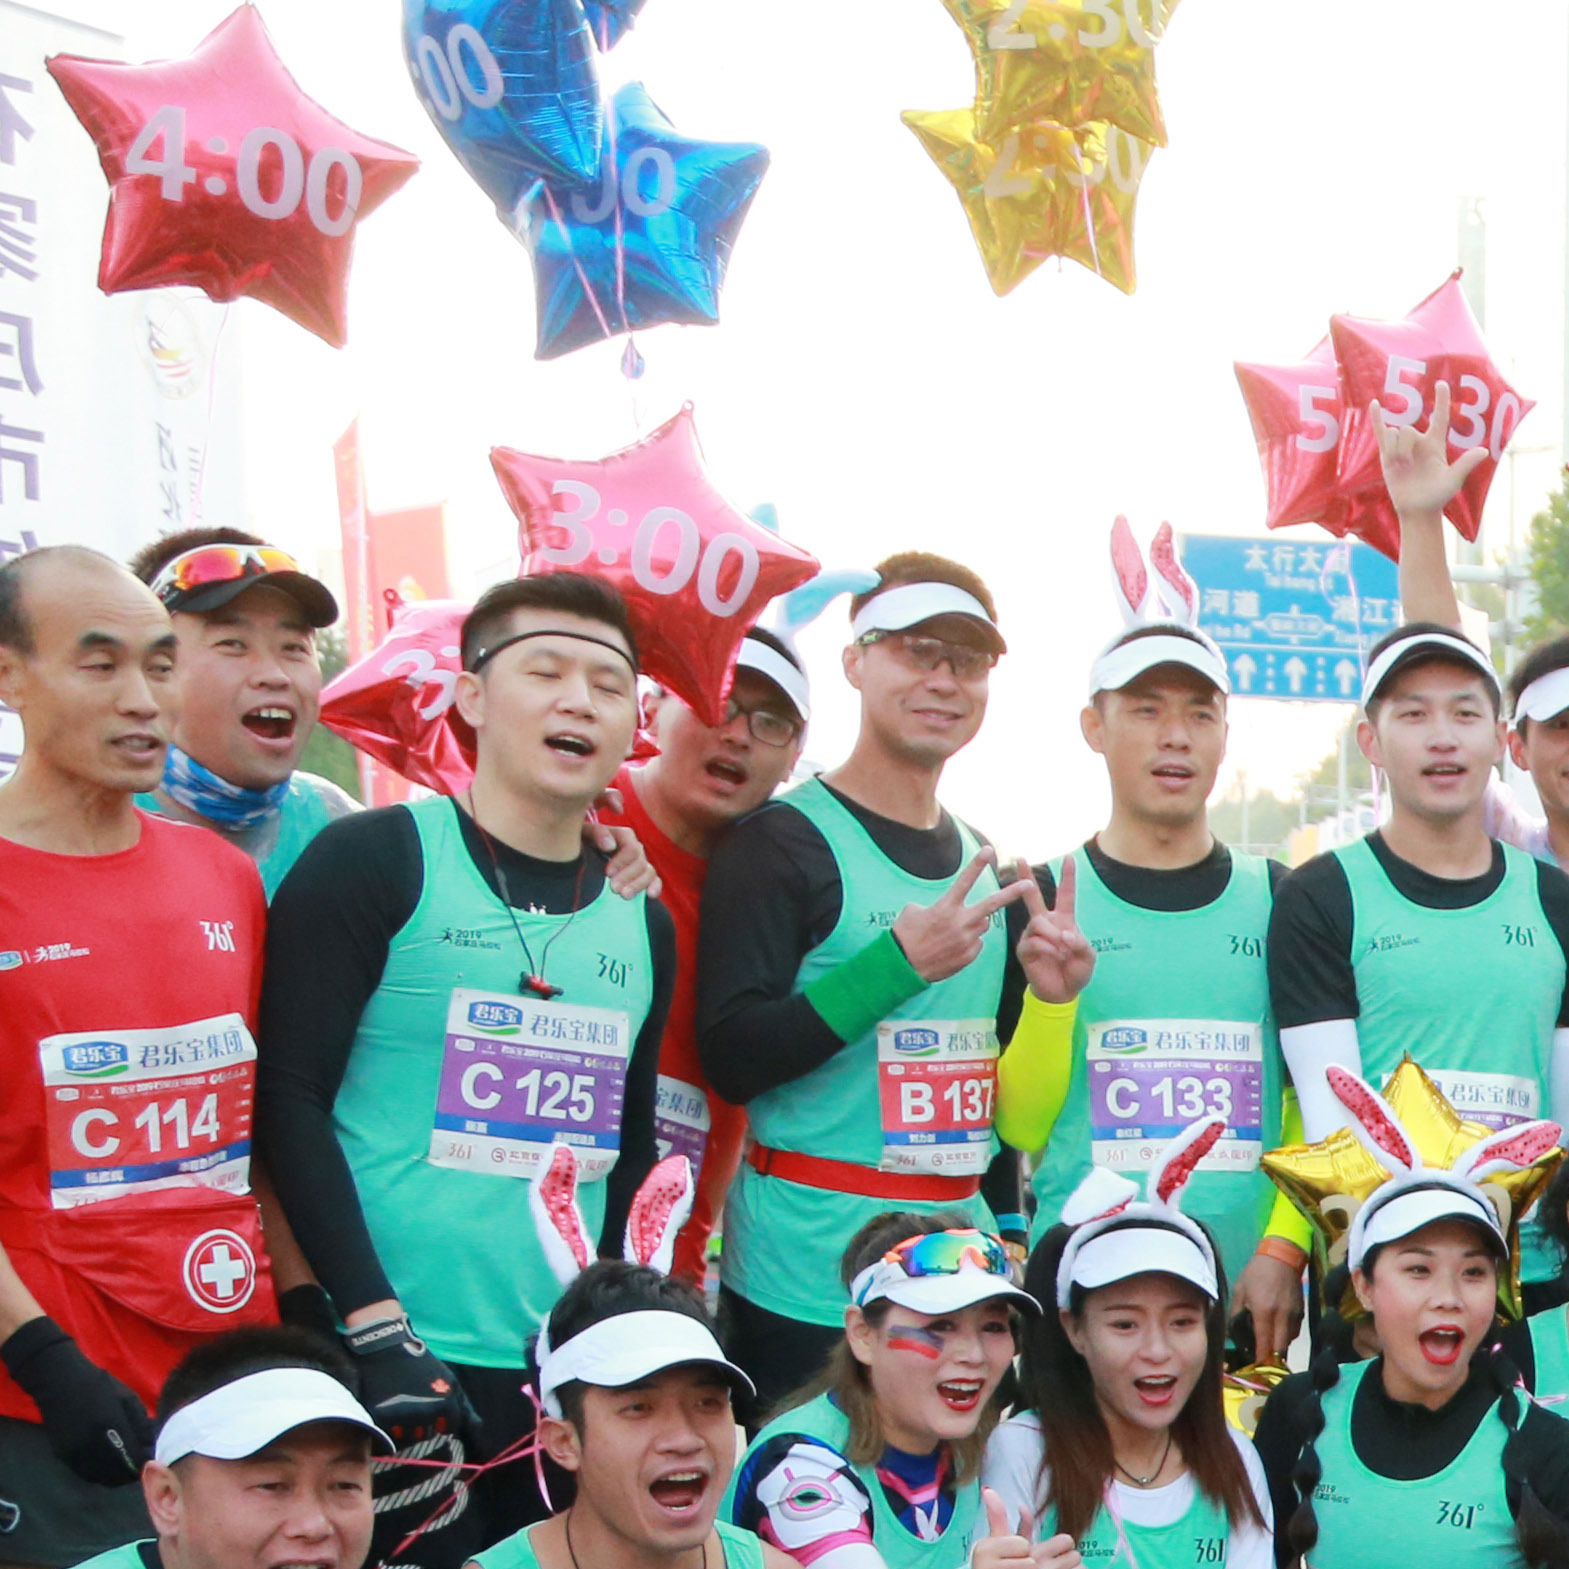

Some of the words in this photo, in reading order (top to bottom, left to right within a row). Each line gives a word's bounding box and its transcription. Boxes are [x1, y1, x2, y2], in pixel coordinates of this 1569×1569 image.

[127, 104, 364, 237] 4:00
[540, 480, 763, 616] 3:00
[200, 920, 234, 952] 361°
[456, 930, 482, 939] 2019
[597, 952, 633, 988] 361°
[475, 1005, 518, 1023] 君乐宝
[531, 1014, 619, 1046] 君乐宝集团
[71, 1045, 122, 1063] 君乐宝
[139, 1030, 244, 1068] 君乐宝集团
[900, 1031, 936, 1045] 君乐宝
[1155, 1031, 1250, 1051] 君乐宝集团
[461, 1062, 504, 1110] C
[516, 1069, 595, 1122] 125
[900, 1082, 935, 1123] B
[944, 1079, 994, 1122] 137
[1106, 1078, 1140, 1118] C
[1151, 1076, 1233, 1118] 133
[1451, 1082, 1530, 1108] 君乐宝集团
[71, 1108, 120, 1158] C
[135, 1093, 220, 1152] 114
[1436, 1500, 1484, 1529] 361°
